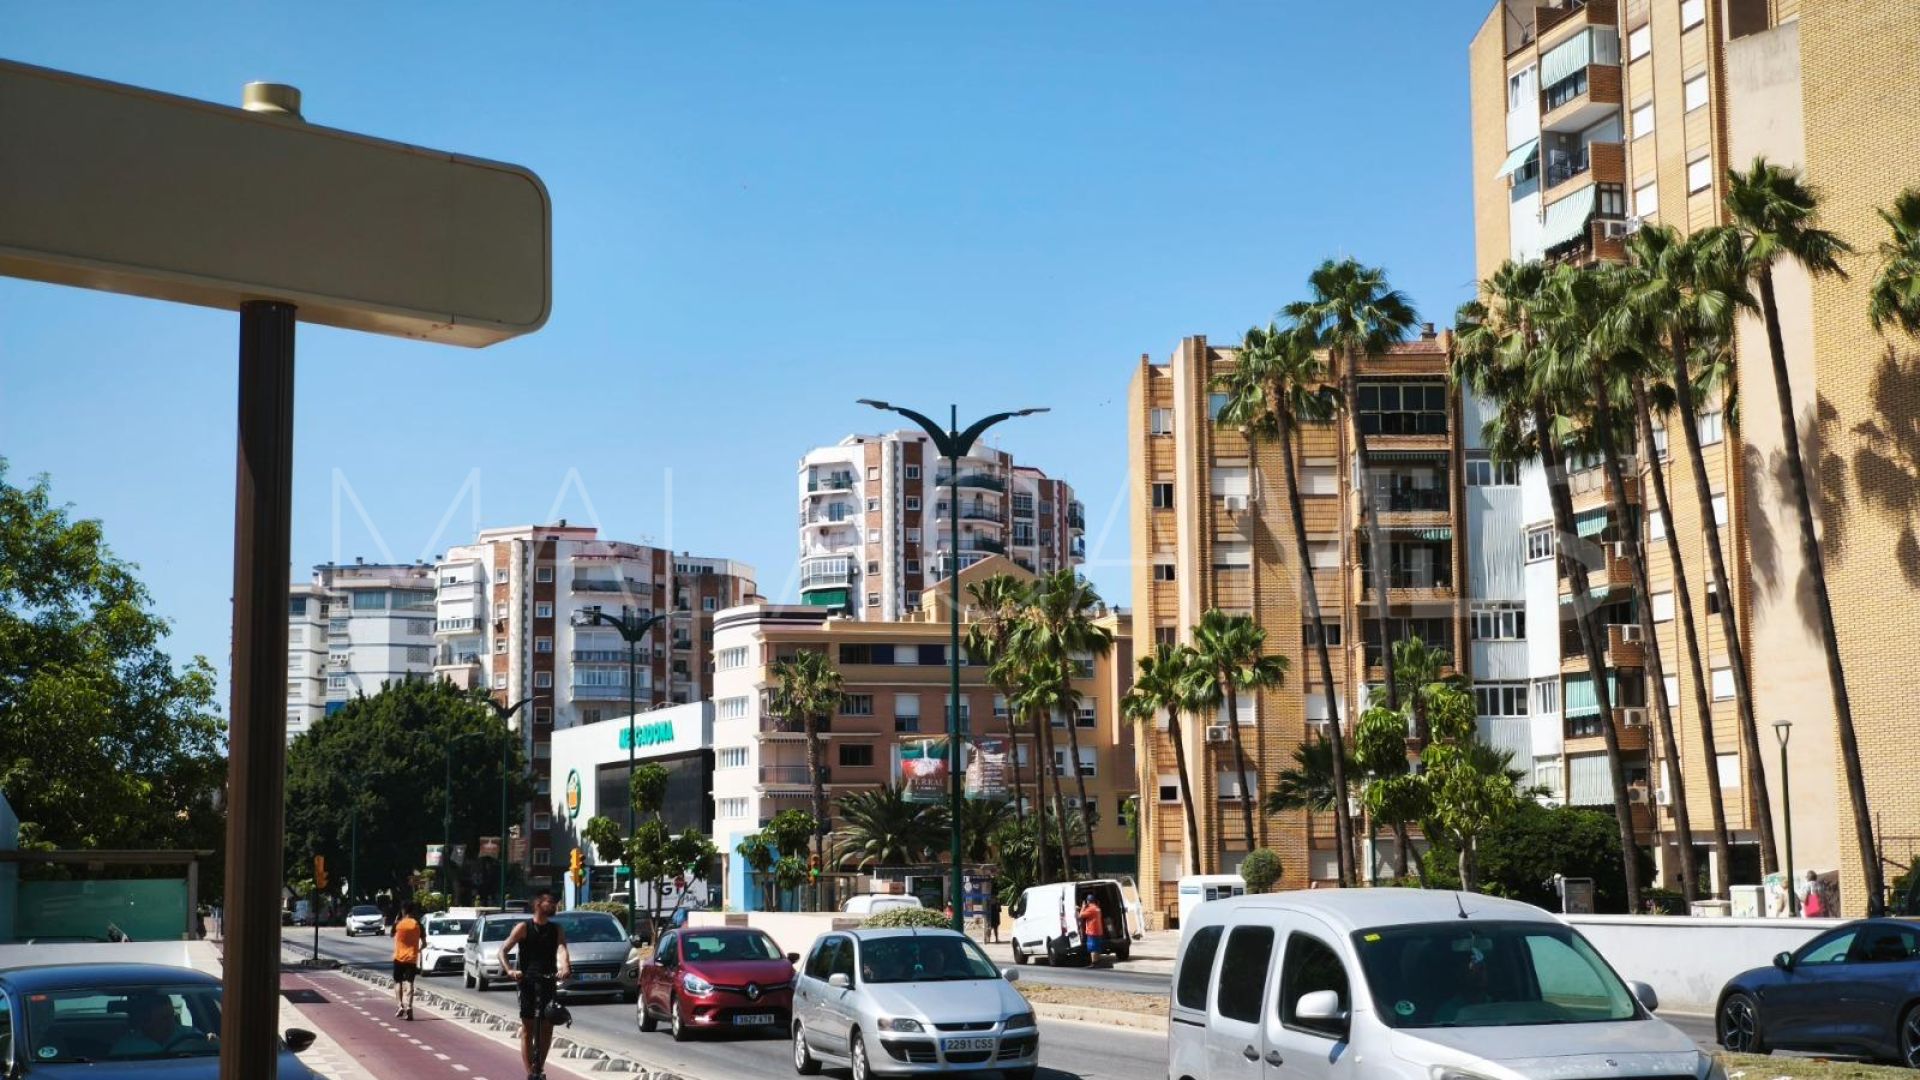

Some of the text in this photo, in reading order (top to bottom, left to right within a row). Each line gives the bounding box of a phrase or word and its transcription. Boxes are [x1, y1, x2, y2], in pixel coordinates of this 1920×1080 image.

[619, 720, 674, 749] MECADONA
[947, 1039, 993, 1050] 2291 CSS
